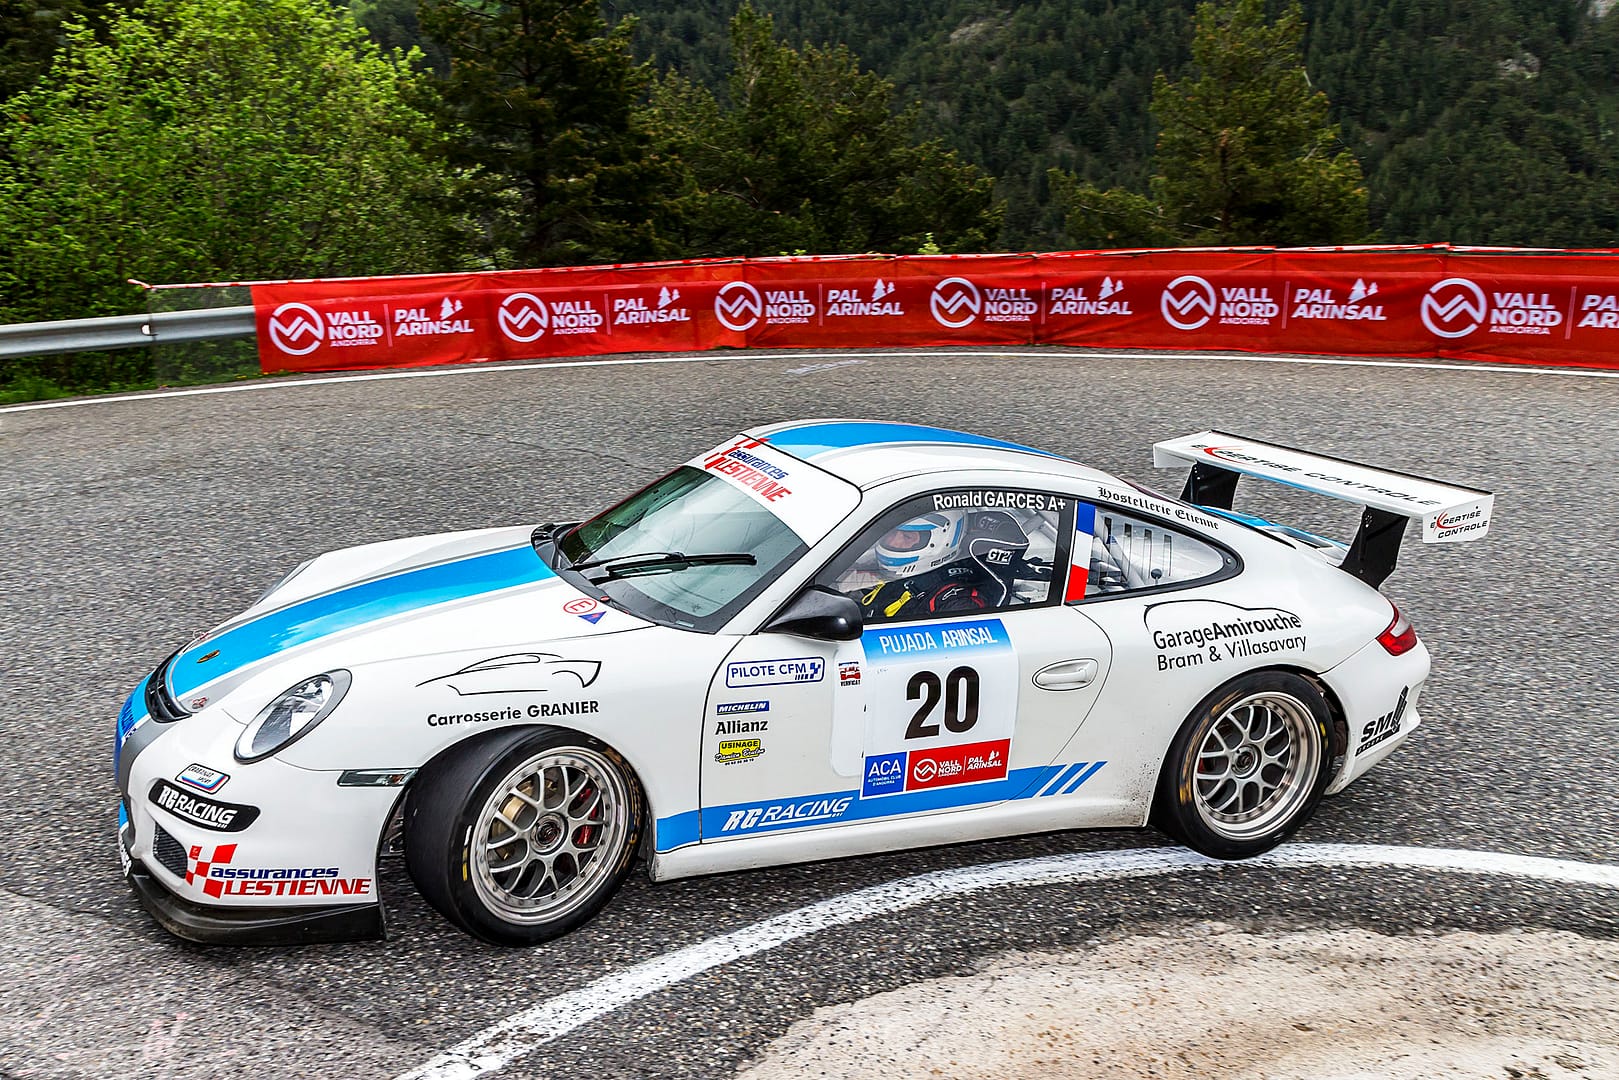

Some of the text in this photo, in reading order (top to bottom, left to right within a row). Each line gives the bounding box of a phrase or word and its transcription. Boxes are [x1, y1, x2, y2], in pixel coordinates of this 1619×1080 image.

[765, 291, 810, 304] VALL
[827, 289, 862, 303] PAL
[984, 288, 1031, 301] VALL
[1051, 288, 1087, 301] PAL
[1220, 288, 1273, 302] VALL
[1294, 288, 1336, 304] PAL
[1493, 292, 1556, 310] VALL
[550, 301, 597, 315] VALL
[614, 298, 648, 312] PAL
[765, 303, 815, 317] NORD
[826, 302, 904, 316] ARINSAL
[984, 301, 1038, 315] NORD
[1049, 301, 1133, 315] ARINSAL
[1219, 303, 1279, 318] NORD
[1580, 294, 1619, 312] PA
[326, 311, 376, 325] VALL
[394, 308, 430, 322] PAL
[614, 309, 691, 325] ARINSAL
[1291, 303, 1387, 320] ARINSAL
[1490, 308, 1563, 327] NORD
[395, 320, 474, 337] ARINSAL
[552, 314, 603, 328] NORD
[328, 324, 384, 339] NORD
[1489, 325, 1551, 335] ANDORRA
[728, 450, 789, 480] assurances
[714, 458, 792, 502] LESTIENNE
[1304, 472, 1441, 506] CONTROLE
[933, 491, 1066, 511] Ronald GARCES A+
[1097, 486, 1219, 530] Hostellerie Etienne
[1437, 520, 1488, 539] CONTROLE
[1153, 613, 1302, 650] GarageAmirouche
[879, 626, 998, 655] PUJADA ARINSAL
[1157, 635, 1307, 671] Bram & Villasavary
[731, 663, 807, 679] PILOTE CFM
[718, 702, 767, 713] MICHELIN
[904, 665, 980, 740] 20
[427, 700, 600, 727] Carrosserie GRANIER
[715, 720, 768, 735] Allianz
[721, 740, 758, 749] USINAGE
[868, 759, 902, 777] ACA
[939, 760, 959, 768] VALL
[966, 759, 1002, 771] ARINSAL
[968, 756, 984, 765] PAL
[938, 765, 962, 775] NORD
[174, 794, 238, 825] RACING
[761, 797, 854, 822] RACING
[211, 867, 340, 879] assurances
[224, 878, 372, 896] LESTIENNE
